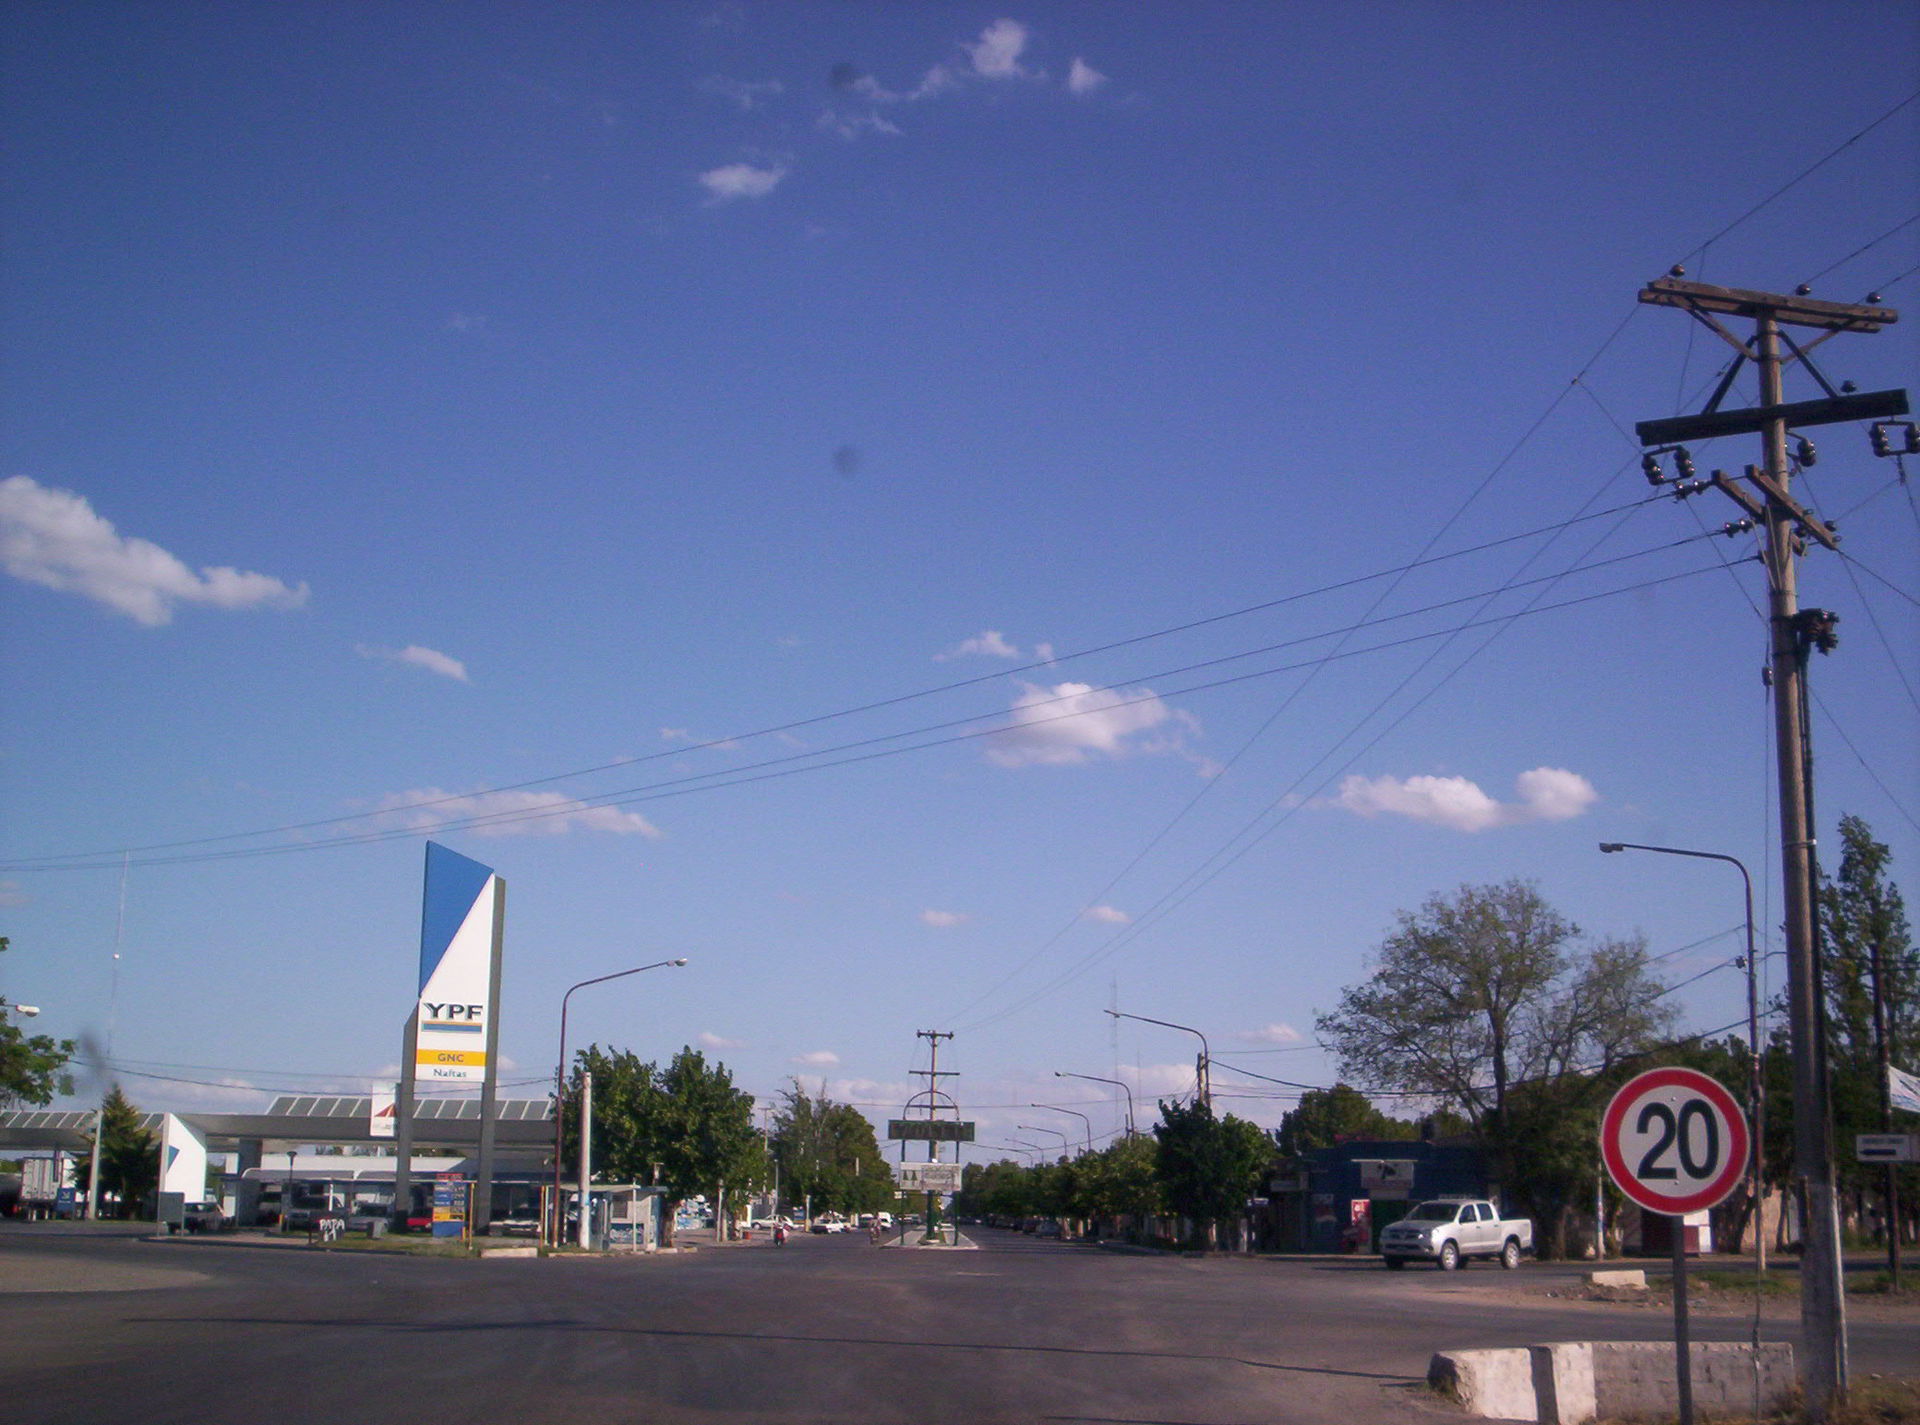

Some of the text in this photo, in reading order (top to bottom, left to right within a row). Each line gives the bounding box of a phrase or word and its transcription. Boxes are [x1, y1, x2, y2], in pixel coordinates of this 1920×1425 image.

[424, 1003, 484, 1020] YPF
[438, 1053, 464, 1063] GNC
[433, 1069, 467, 1078] Naftas
[1637, 1098, 1719, 1180] 20
